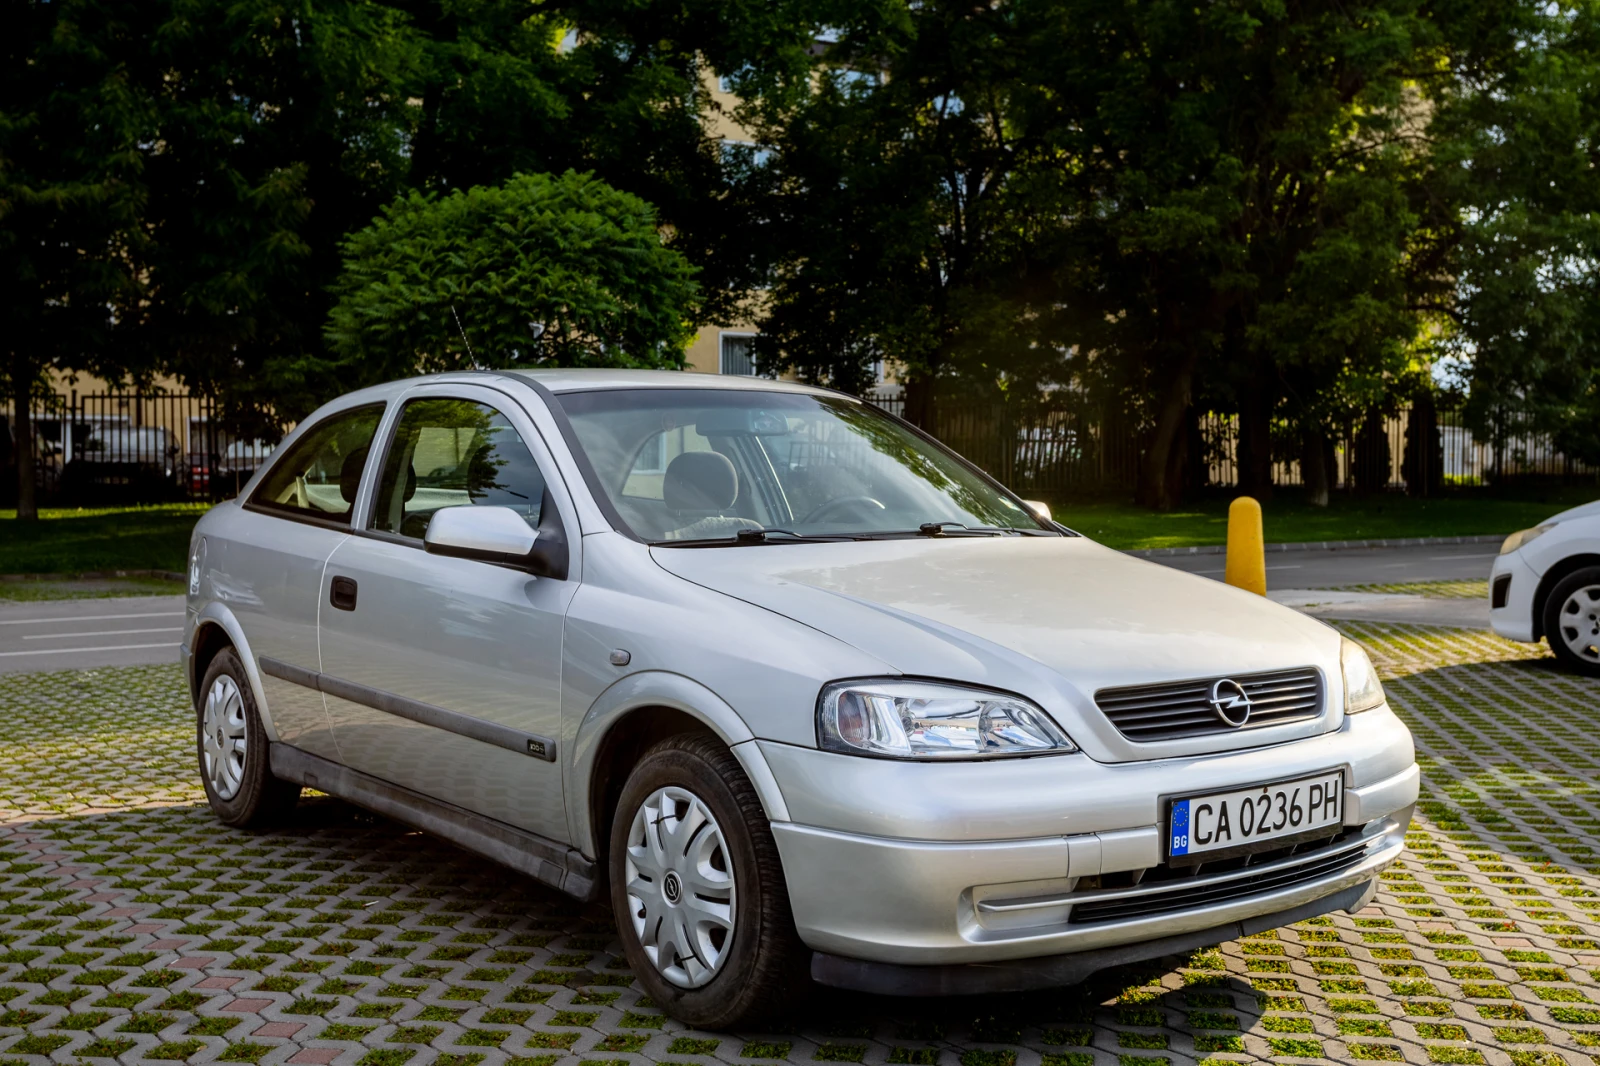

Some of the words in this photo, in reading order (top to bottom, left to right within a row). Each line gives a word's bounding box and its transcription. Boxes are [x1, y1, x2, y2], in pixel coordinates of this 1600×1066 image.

[1194, 800, 1232, 845] CA
[1239, 788, 1303, 837] 0236
[1308, 779, 1339, 824] PH
[1173, 834, 1188, 849] BG
